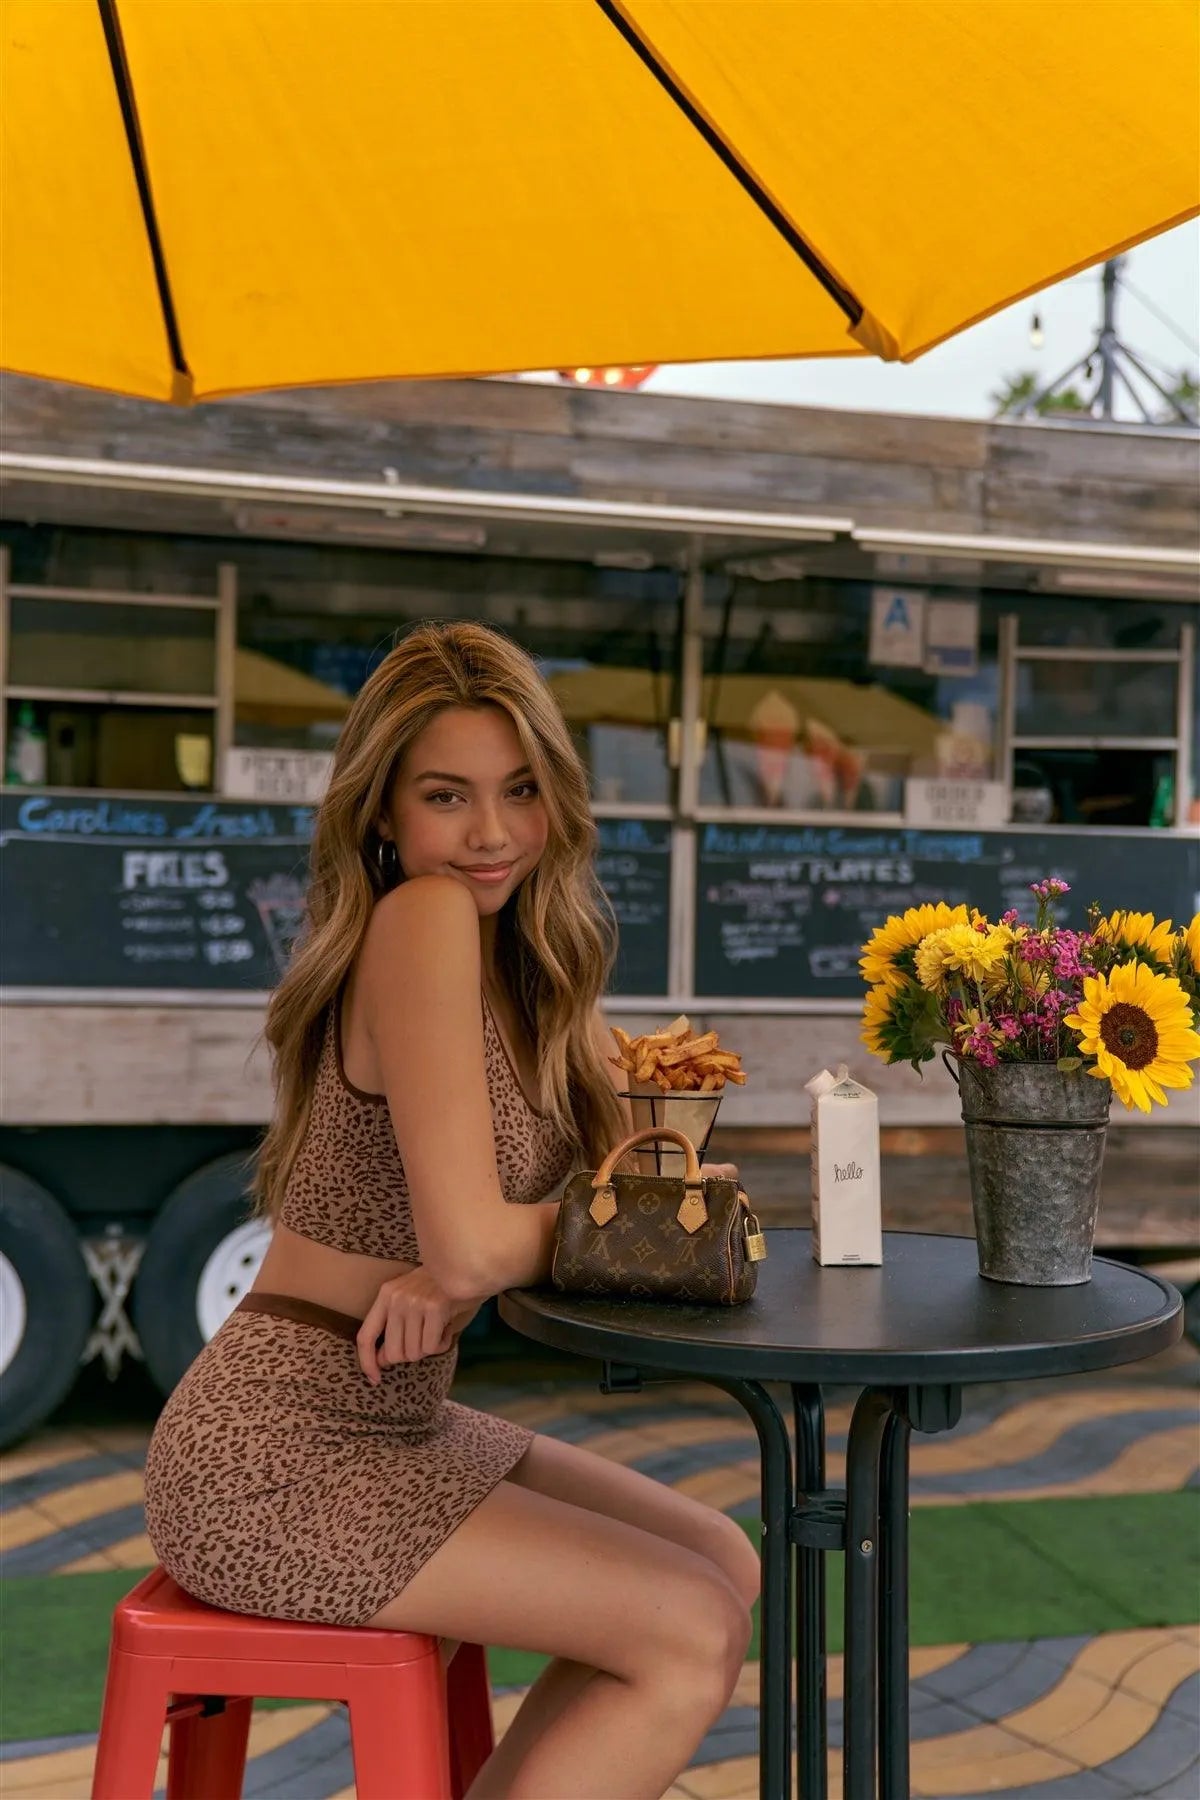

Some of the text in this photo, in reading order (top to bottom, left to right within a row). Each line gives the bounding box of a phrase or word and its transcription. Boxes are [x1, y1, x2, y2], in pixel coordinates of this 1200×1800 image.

[884, 596, 911, 632] A
[123, 851, 230, 889] FRIES
[834, 1161, 864, 1183] hello
